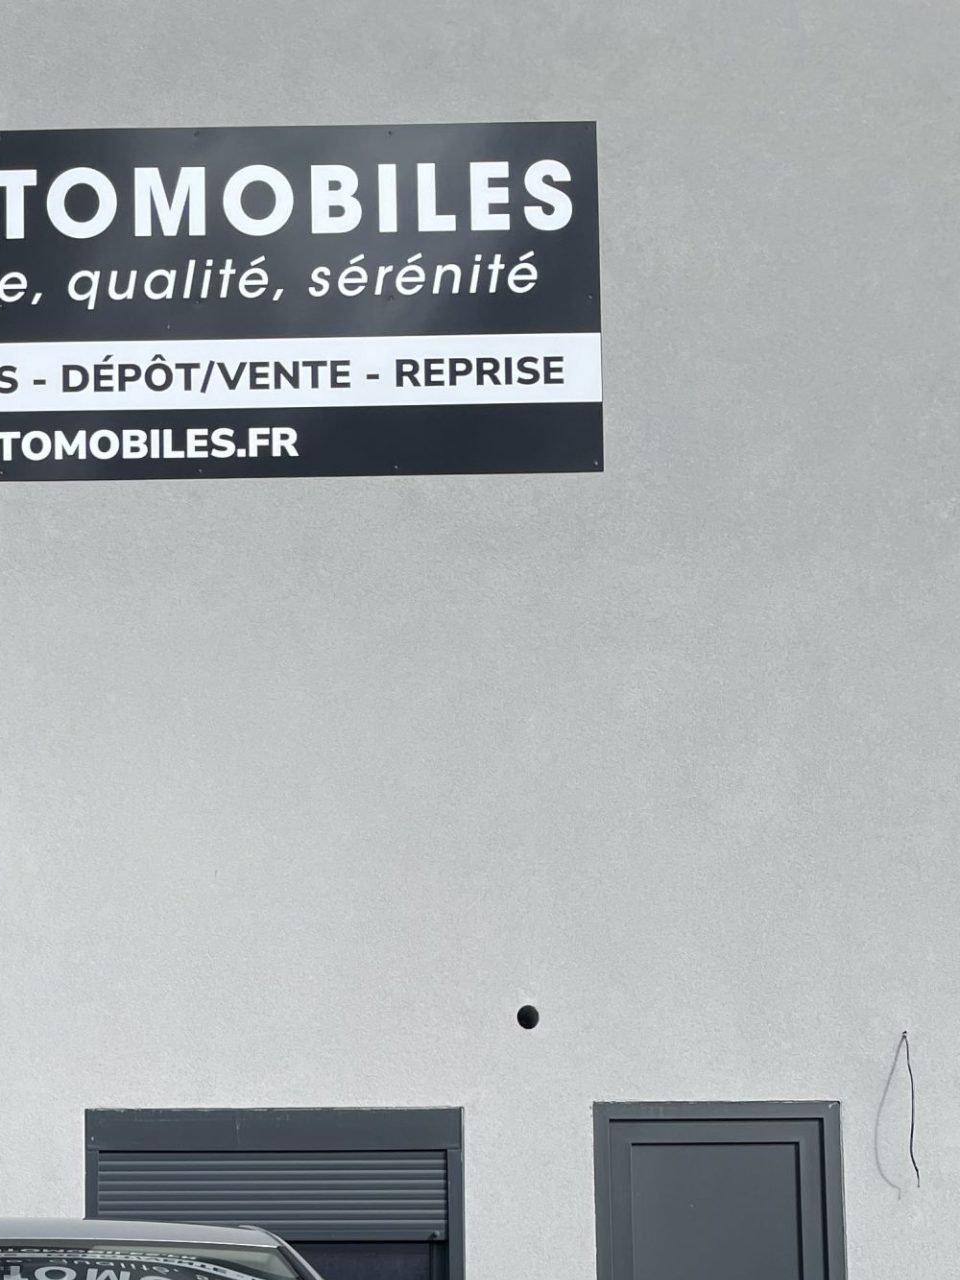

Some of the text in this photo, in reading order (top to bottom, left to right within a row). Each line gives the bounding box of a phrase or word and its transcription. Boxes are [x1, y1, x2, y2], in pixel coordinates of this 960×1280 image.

[67, 255, 285, 310] qualité,
[308, 250, 539, 298] sérénité
[61, 354, 351, 394] DÉPÔT/VENTE
[395, 355, 565, 388] REPRISE
